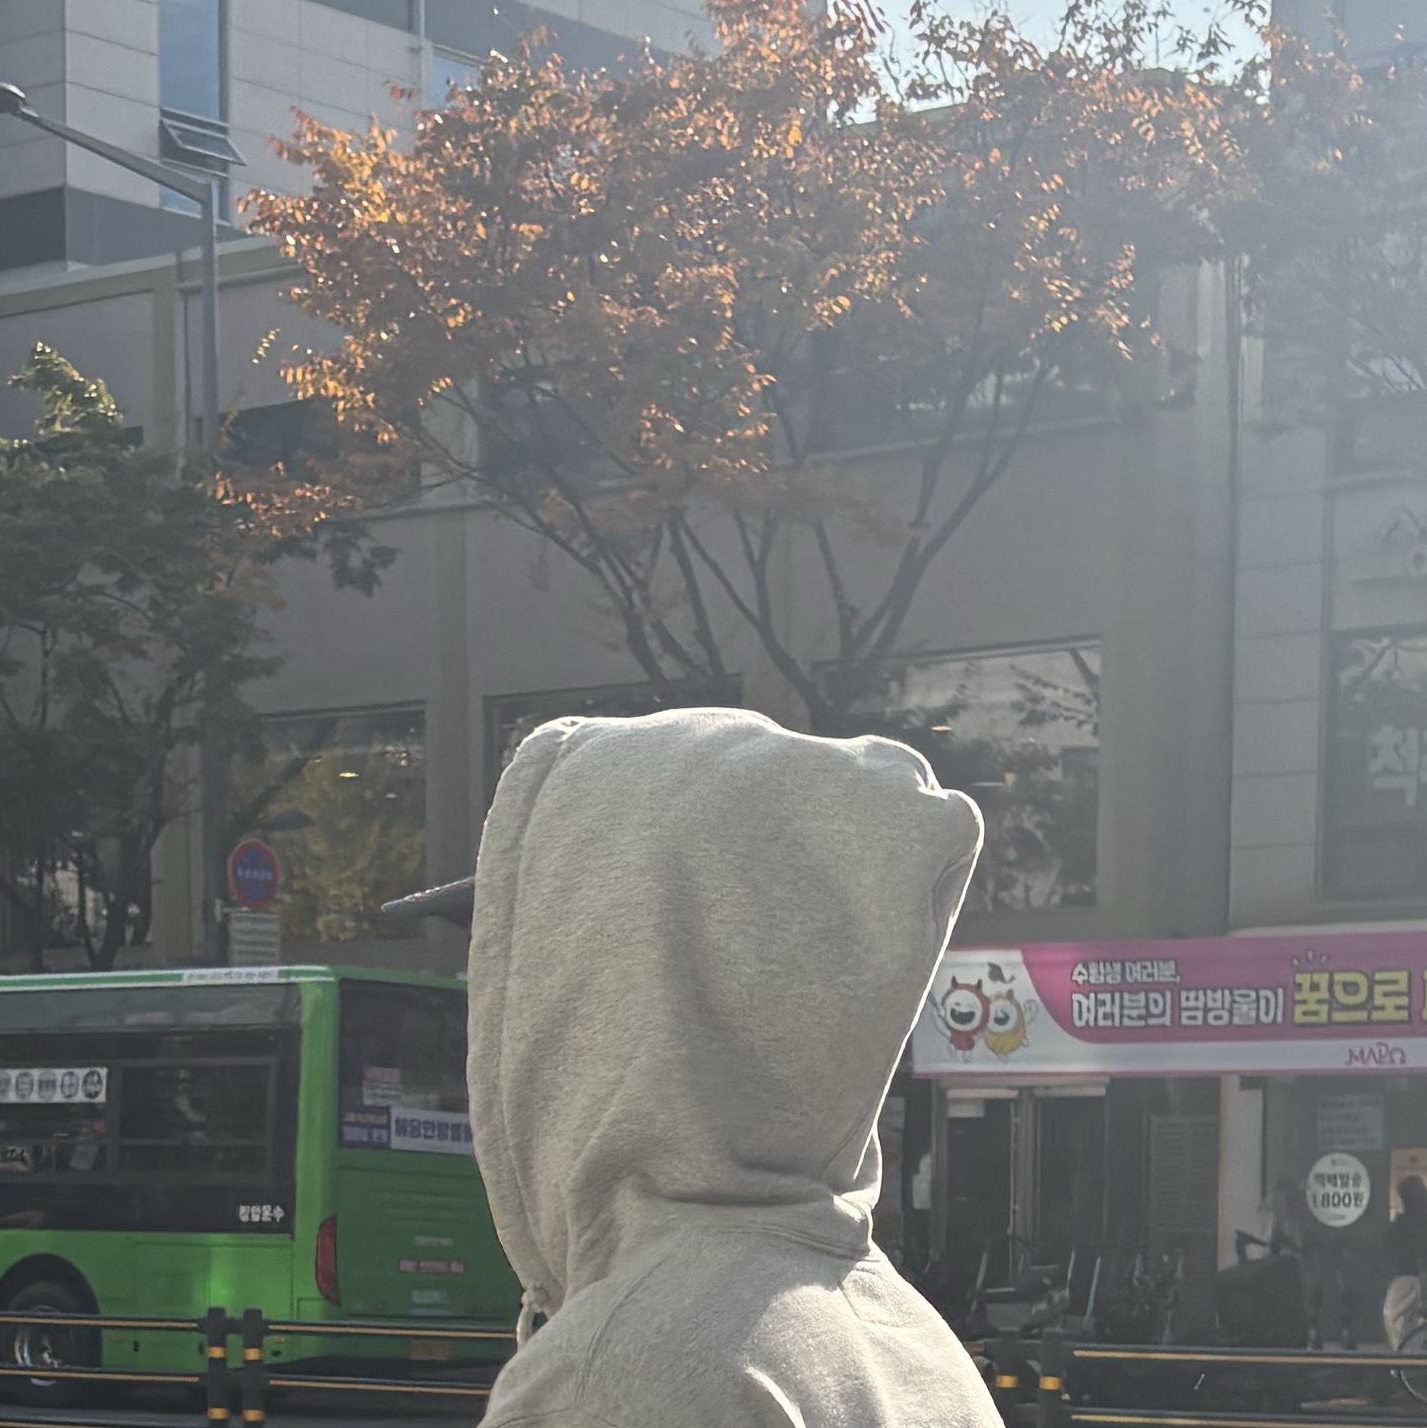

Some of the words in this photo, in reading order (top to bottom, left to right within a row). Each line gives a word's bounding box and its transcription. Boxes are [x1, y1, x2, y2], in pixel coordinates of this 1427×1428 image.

[1071, 960, 1121, 984] 수험생
[1071, 990, 1172, 1027] 여러분의
[1179, 987, 1285, 1026] 땀방울이
[1293, 970, 1410, 1024] 꿈으로
